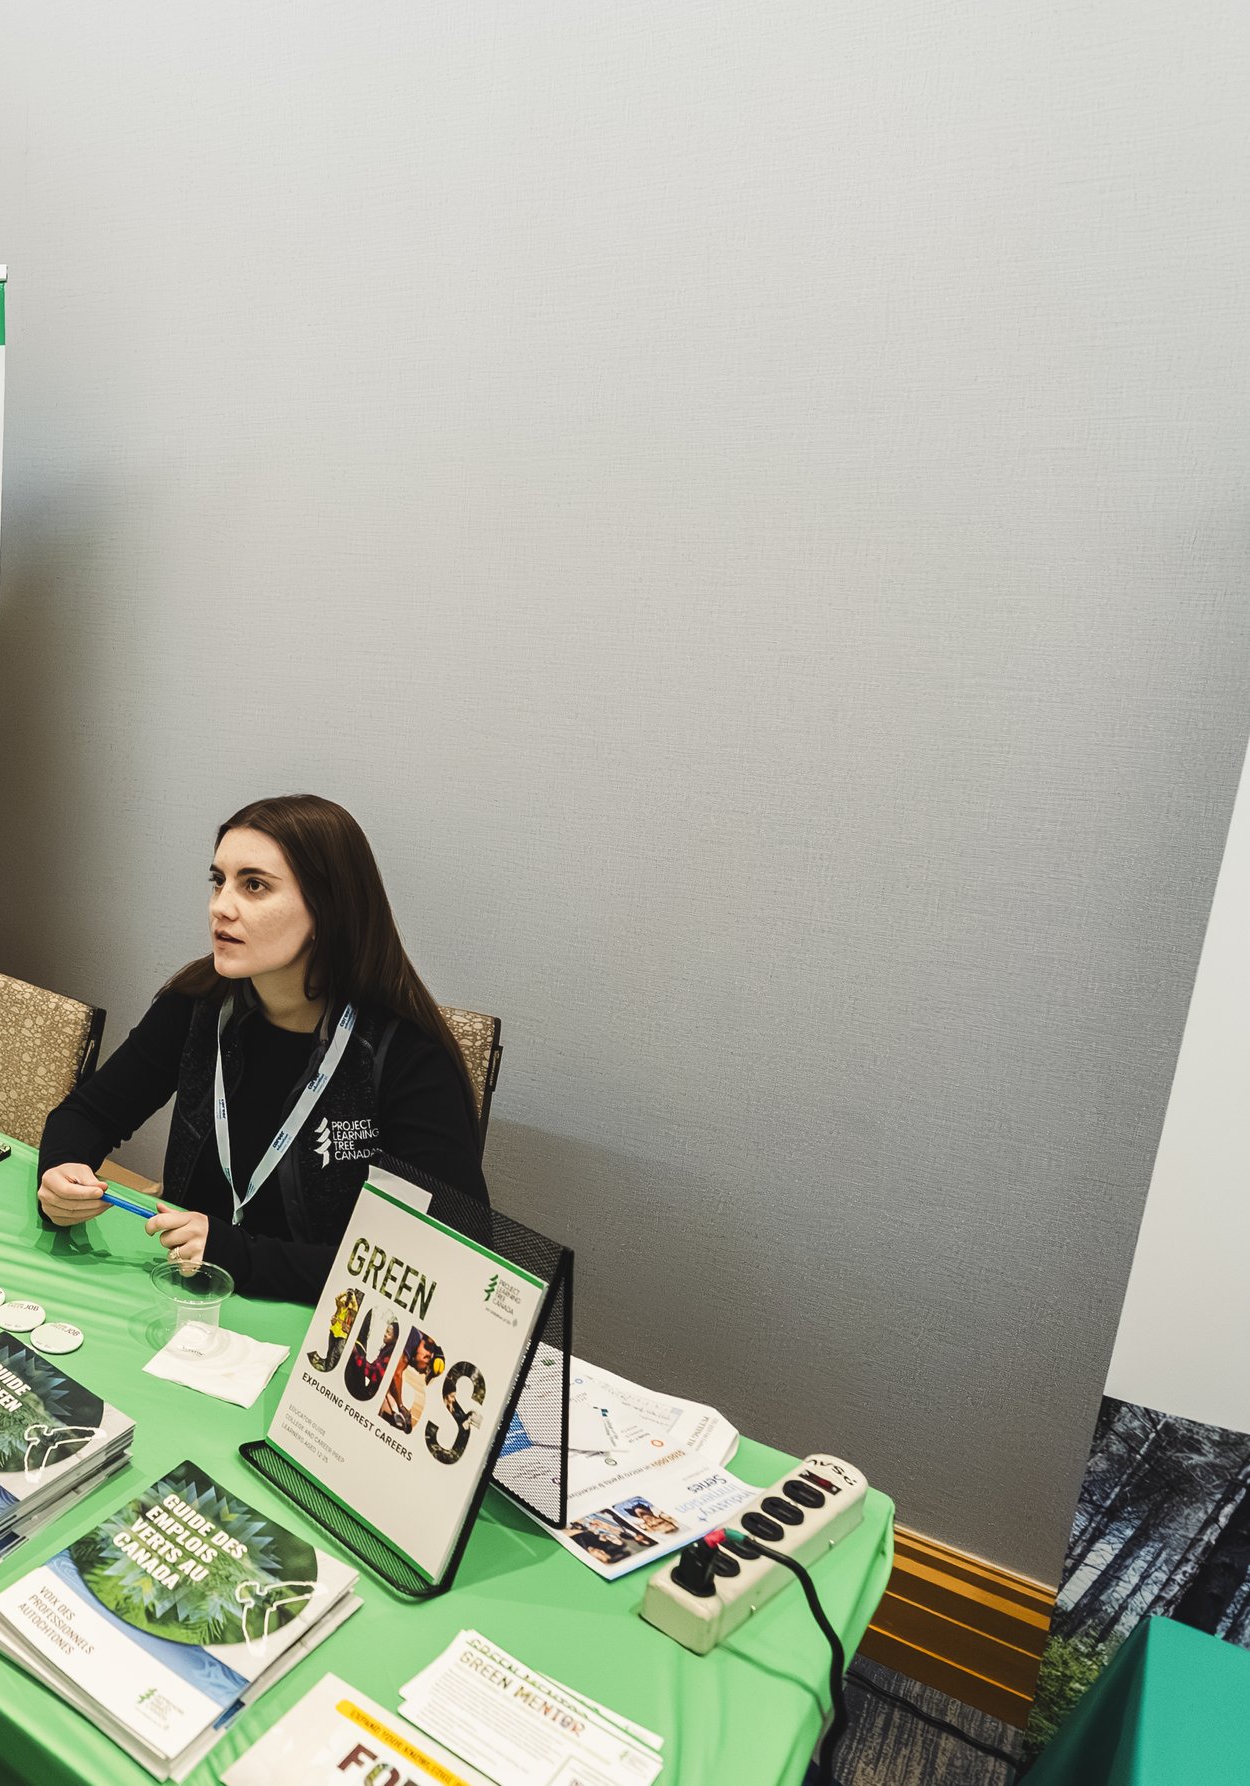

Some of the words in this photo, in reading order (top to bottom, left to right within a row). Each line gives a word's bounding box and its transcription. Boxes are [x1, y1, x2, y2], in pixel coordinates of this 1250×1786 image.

[331, 1119, 372, 1130] PROJECT
[332, 1128, 380, 1140] LEARNING
[333, 1141, 355, 1151] TREE
[347, 1237, 437, 1321] GREEN
[24, 1304, 39, 1312] JOB
[64, 1327, 80, 1337] JOB
[306, 1287, 487, 1465] JOBS
[281, 1423, 305, 1443] LEARNERS
[303, 1440, 317, 1454] AGED
[285, 1413, 305, 1432] COLLEGE
[304, 1429, 315, 1439] AND
[314, 1435, 333, 1453] CAREER
[288, 1404, 313, 1426] EDUCATOR
[311, 1421, 326, 1437] GUIDE
[301, 1372, 344, 1409] EXPLORING
[343, 1405, 375, 1432] FOREST
[374, 1428, 413, 1461] CAREERS
[687, 1474, 727, 1493] Series
[130, 1516, 183, 1563] VERTS
[177, 1559, 209, 1581] AU
[145, 1505, 218, 1563] EMPLOIS
[163, 1494, 216, 1537] GUIDE
[210, 1530, 248, 1559] DES
[113, 1532, 180, 1590] CANADA
[29, 1594, 94, 1654] PROFESSIONNELS
[40, 1586, 60, 1606] VOIX
[57, 1604, 76, 1620] DES
[18, 1603, 74, 1655] AUTOCHTONES
[459, 1651, 513, 1690] GREEN
[513, 1686, 586, 1737] MENTOR
